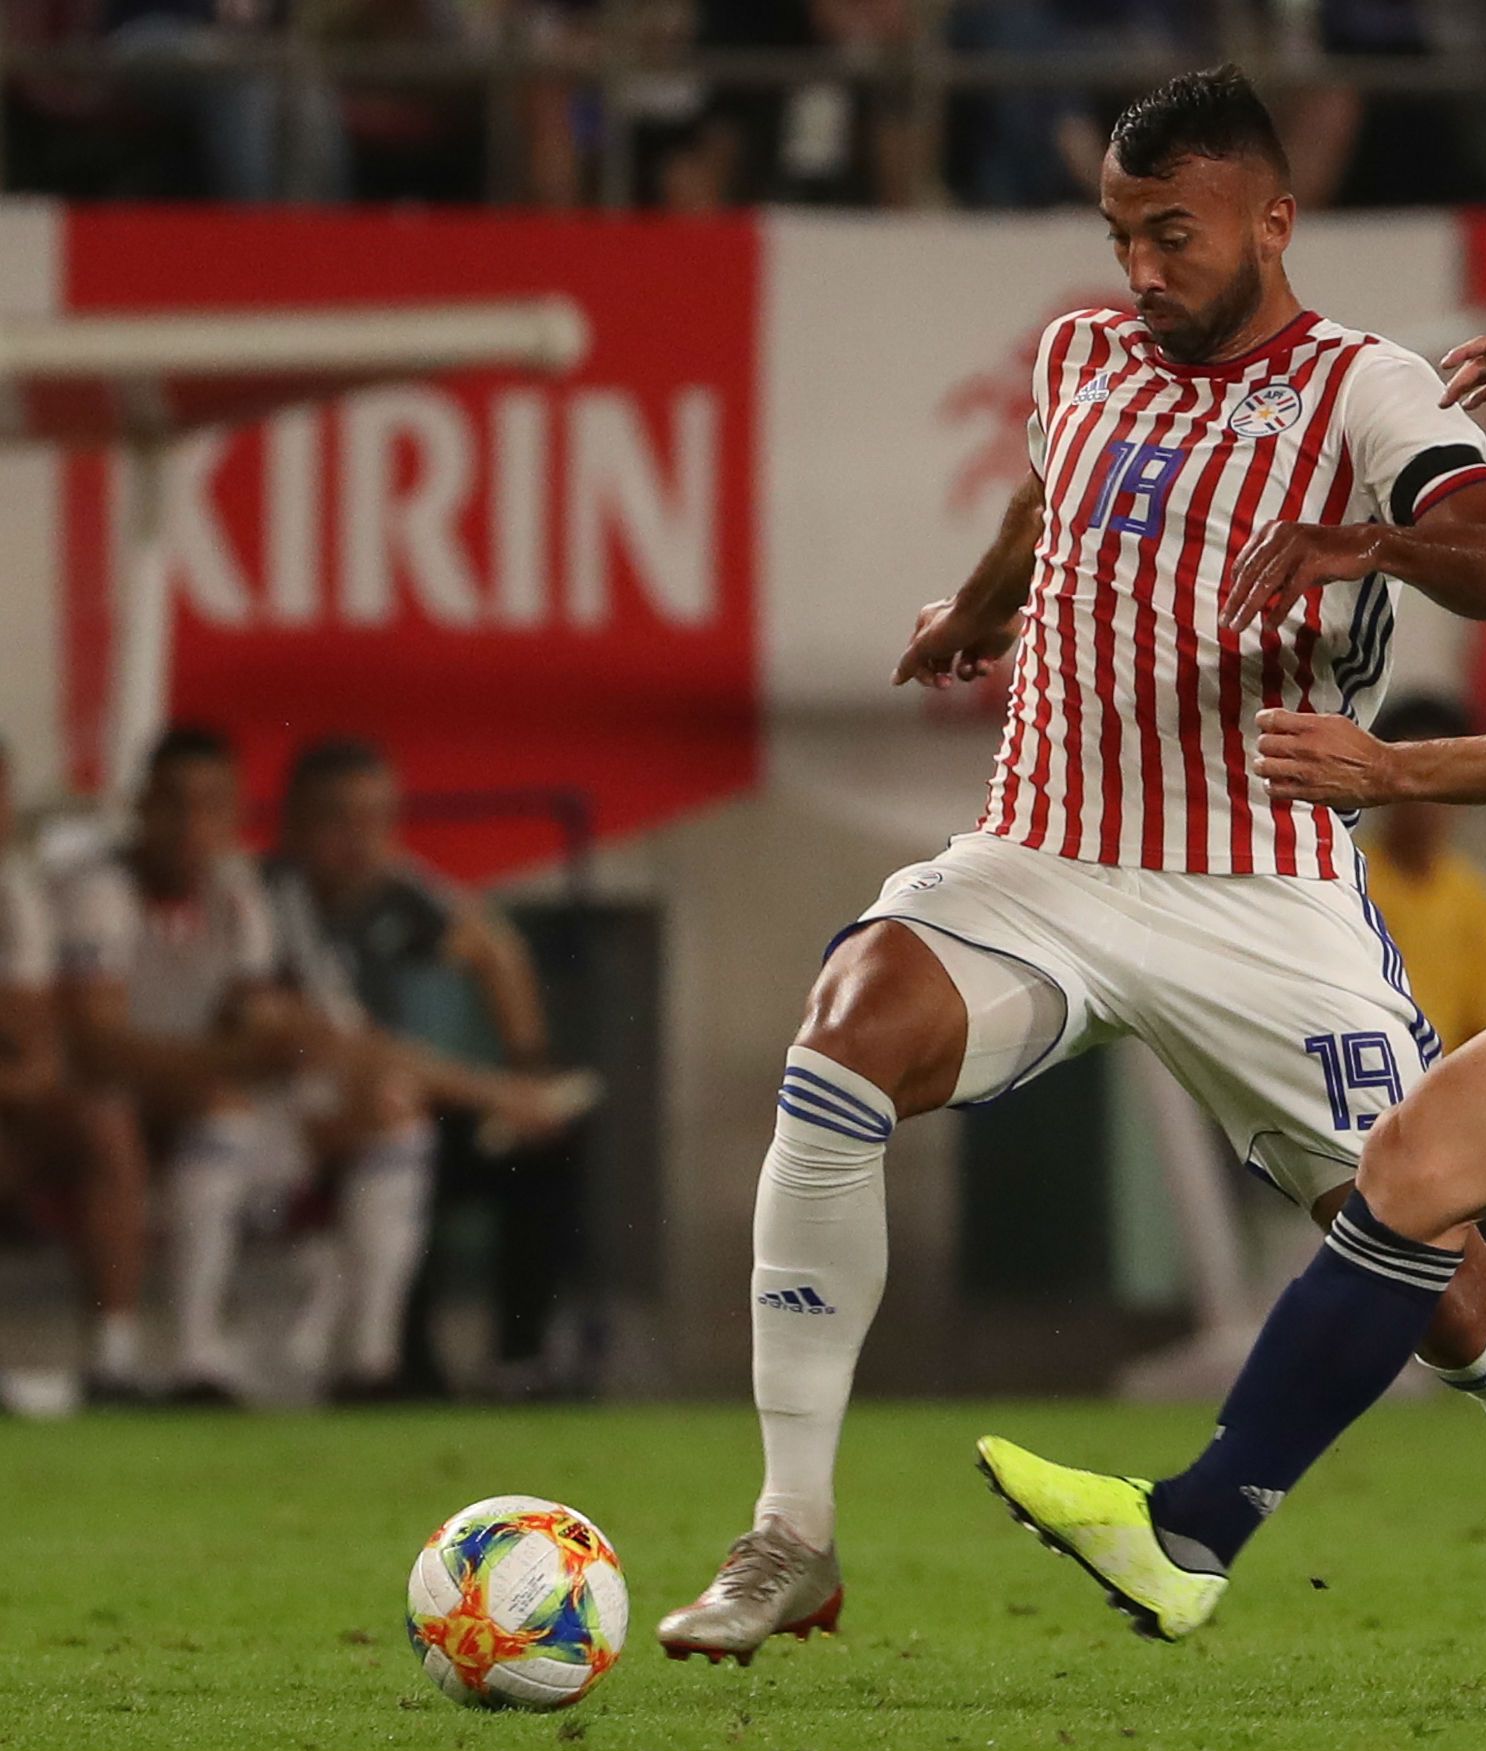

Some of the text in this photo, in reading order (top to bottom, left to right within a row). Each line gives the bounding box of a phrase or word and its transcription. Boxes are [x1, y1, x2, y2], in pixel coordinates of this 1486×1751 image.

[112, 386, 722, 631] KIRIN
[1088, 440, 1185, 539] 19
[1304, 1031, 1404, 1131] 19
